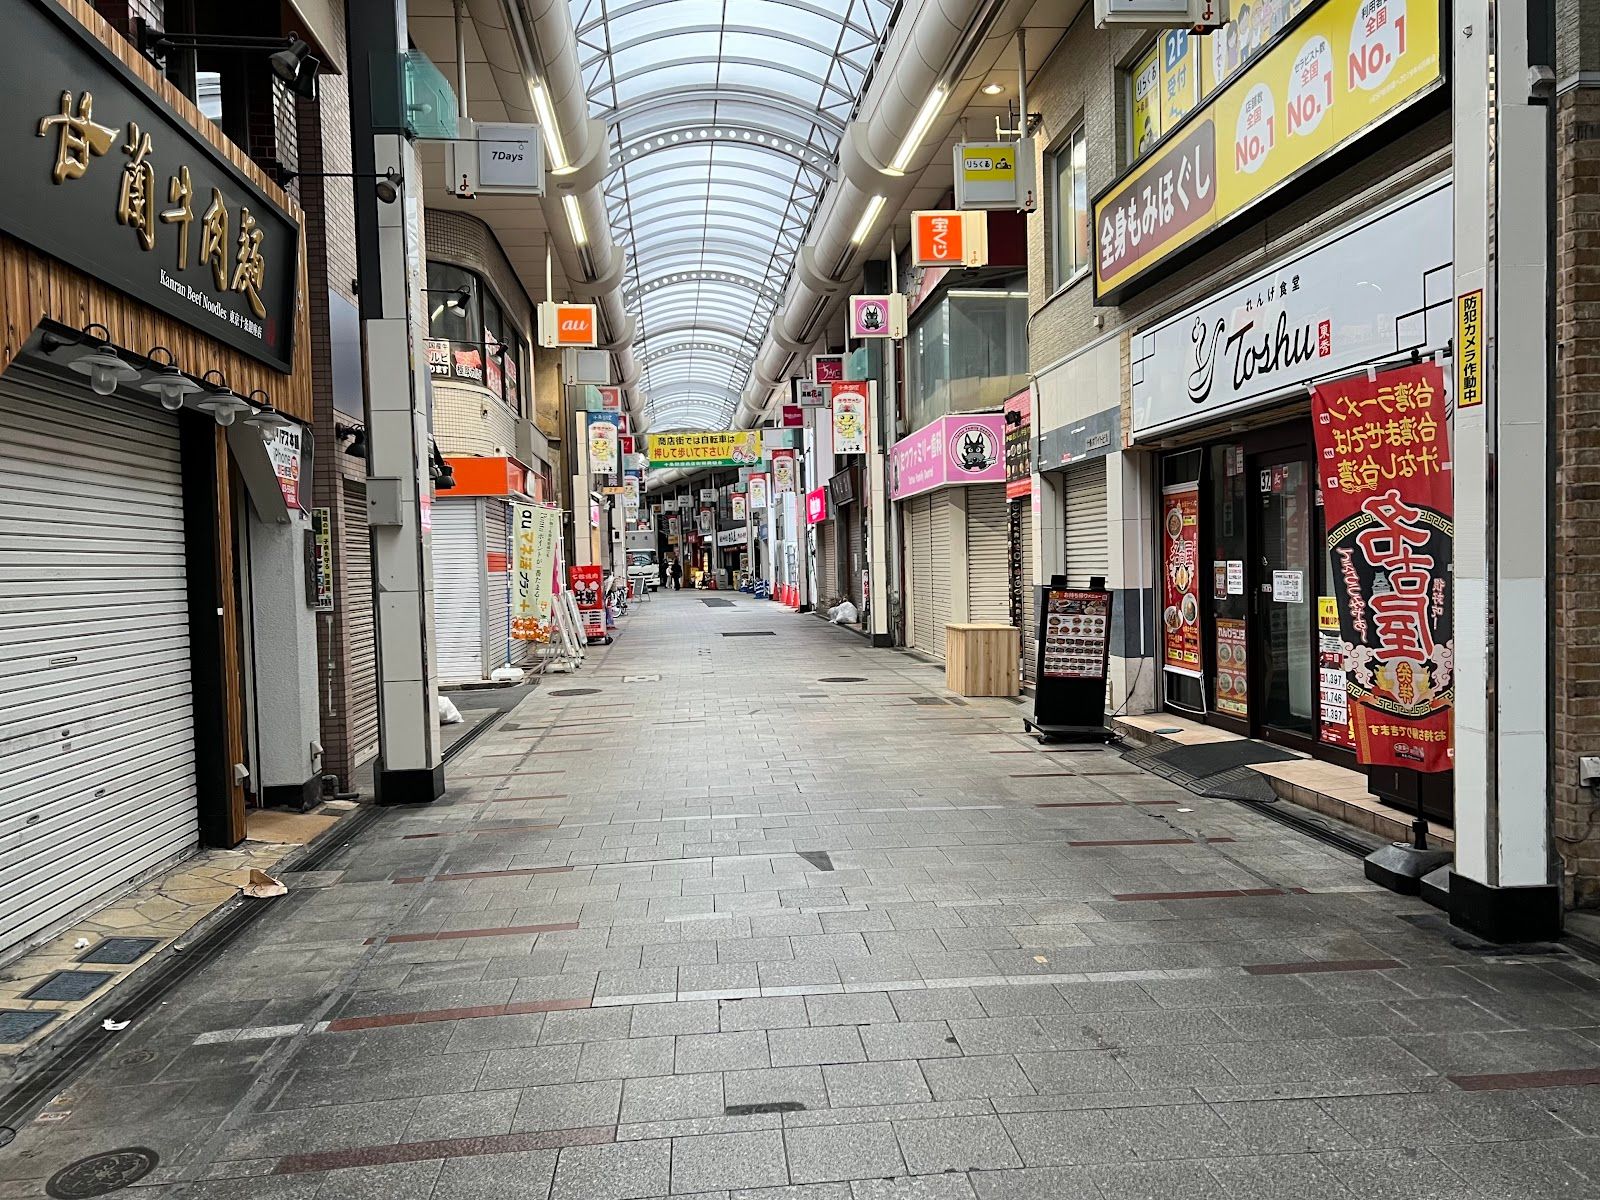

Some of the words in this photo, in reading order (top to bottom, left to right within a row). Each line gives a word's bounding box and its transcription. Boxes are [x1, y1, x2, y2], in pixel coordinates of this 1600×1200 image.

[1366, 6, 1387, 37] 全国
[1168, 30, 1187, 67] 2F
[1295, 41, 1326, 74] セラピスト数
[1349, 15, 1406, 92] No.1
[1137, 65, 1157, 95] りらくる
[1168, 64, 1187, 101] 受付
[1301, 59, 1319, 88] 全国
[1245, 91, 1263, 114] 店舗数
[1246, 106, 1262, 131] 全国
[1287, 70, 1333, 137] No.1
[491, 151, 524, 162] 7Days
[1235, 115, 1275, 174] No.1
[966, 160, 991, 169] りらくる
[1101, 144, 1211, 270] 全身もみほぐし
[931, 217, 949, 259] 宝くじ
[160, 269, 186, 298] Kanran
[187, 285, 203, 307] Beef
[202, 293, 227, 320] Noodles
[1246, 274, 1300, 312] れんげ食堂
[561, 319, 589, 331] au
[1319, 323, 1330, 355] 東秀
[1224, 311, 1315, 390] Toshu
[1464, 296, 1476, 402] 防犯カメラ作動中
[658, 436, 735, 445] 商店街では自転車は
